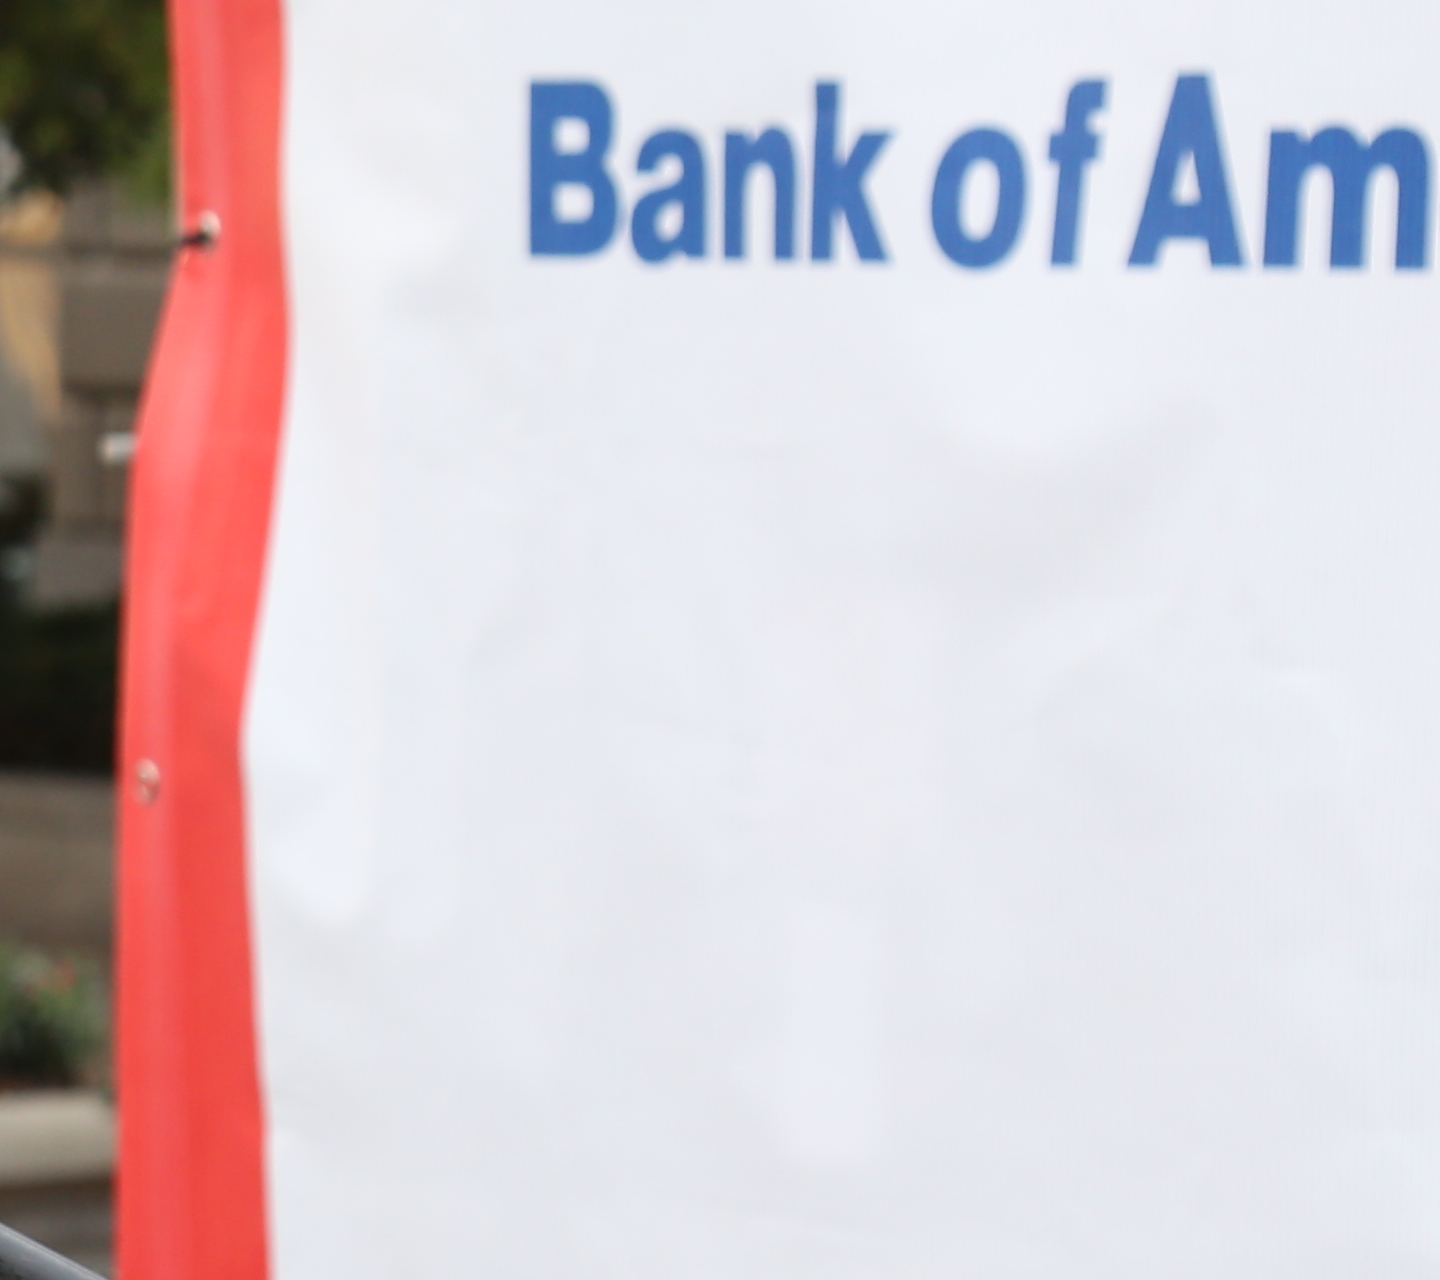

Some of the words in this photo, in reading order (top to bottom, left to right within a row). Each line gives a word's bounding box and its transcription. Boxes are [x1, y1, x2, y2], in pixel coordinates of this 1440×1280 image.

[528, 77, 896, 265] Bank
[930, 77, 1110, 269] of
[1124, 70, 1436, 271] Am
